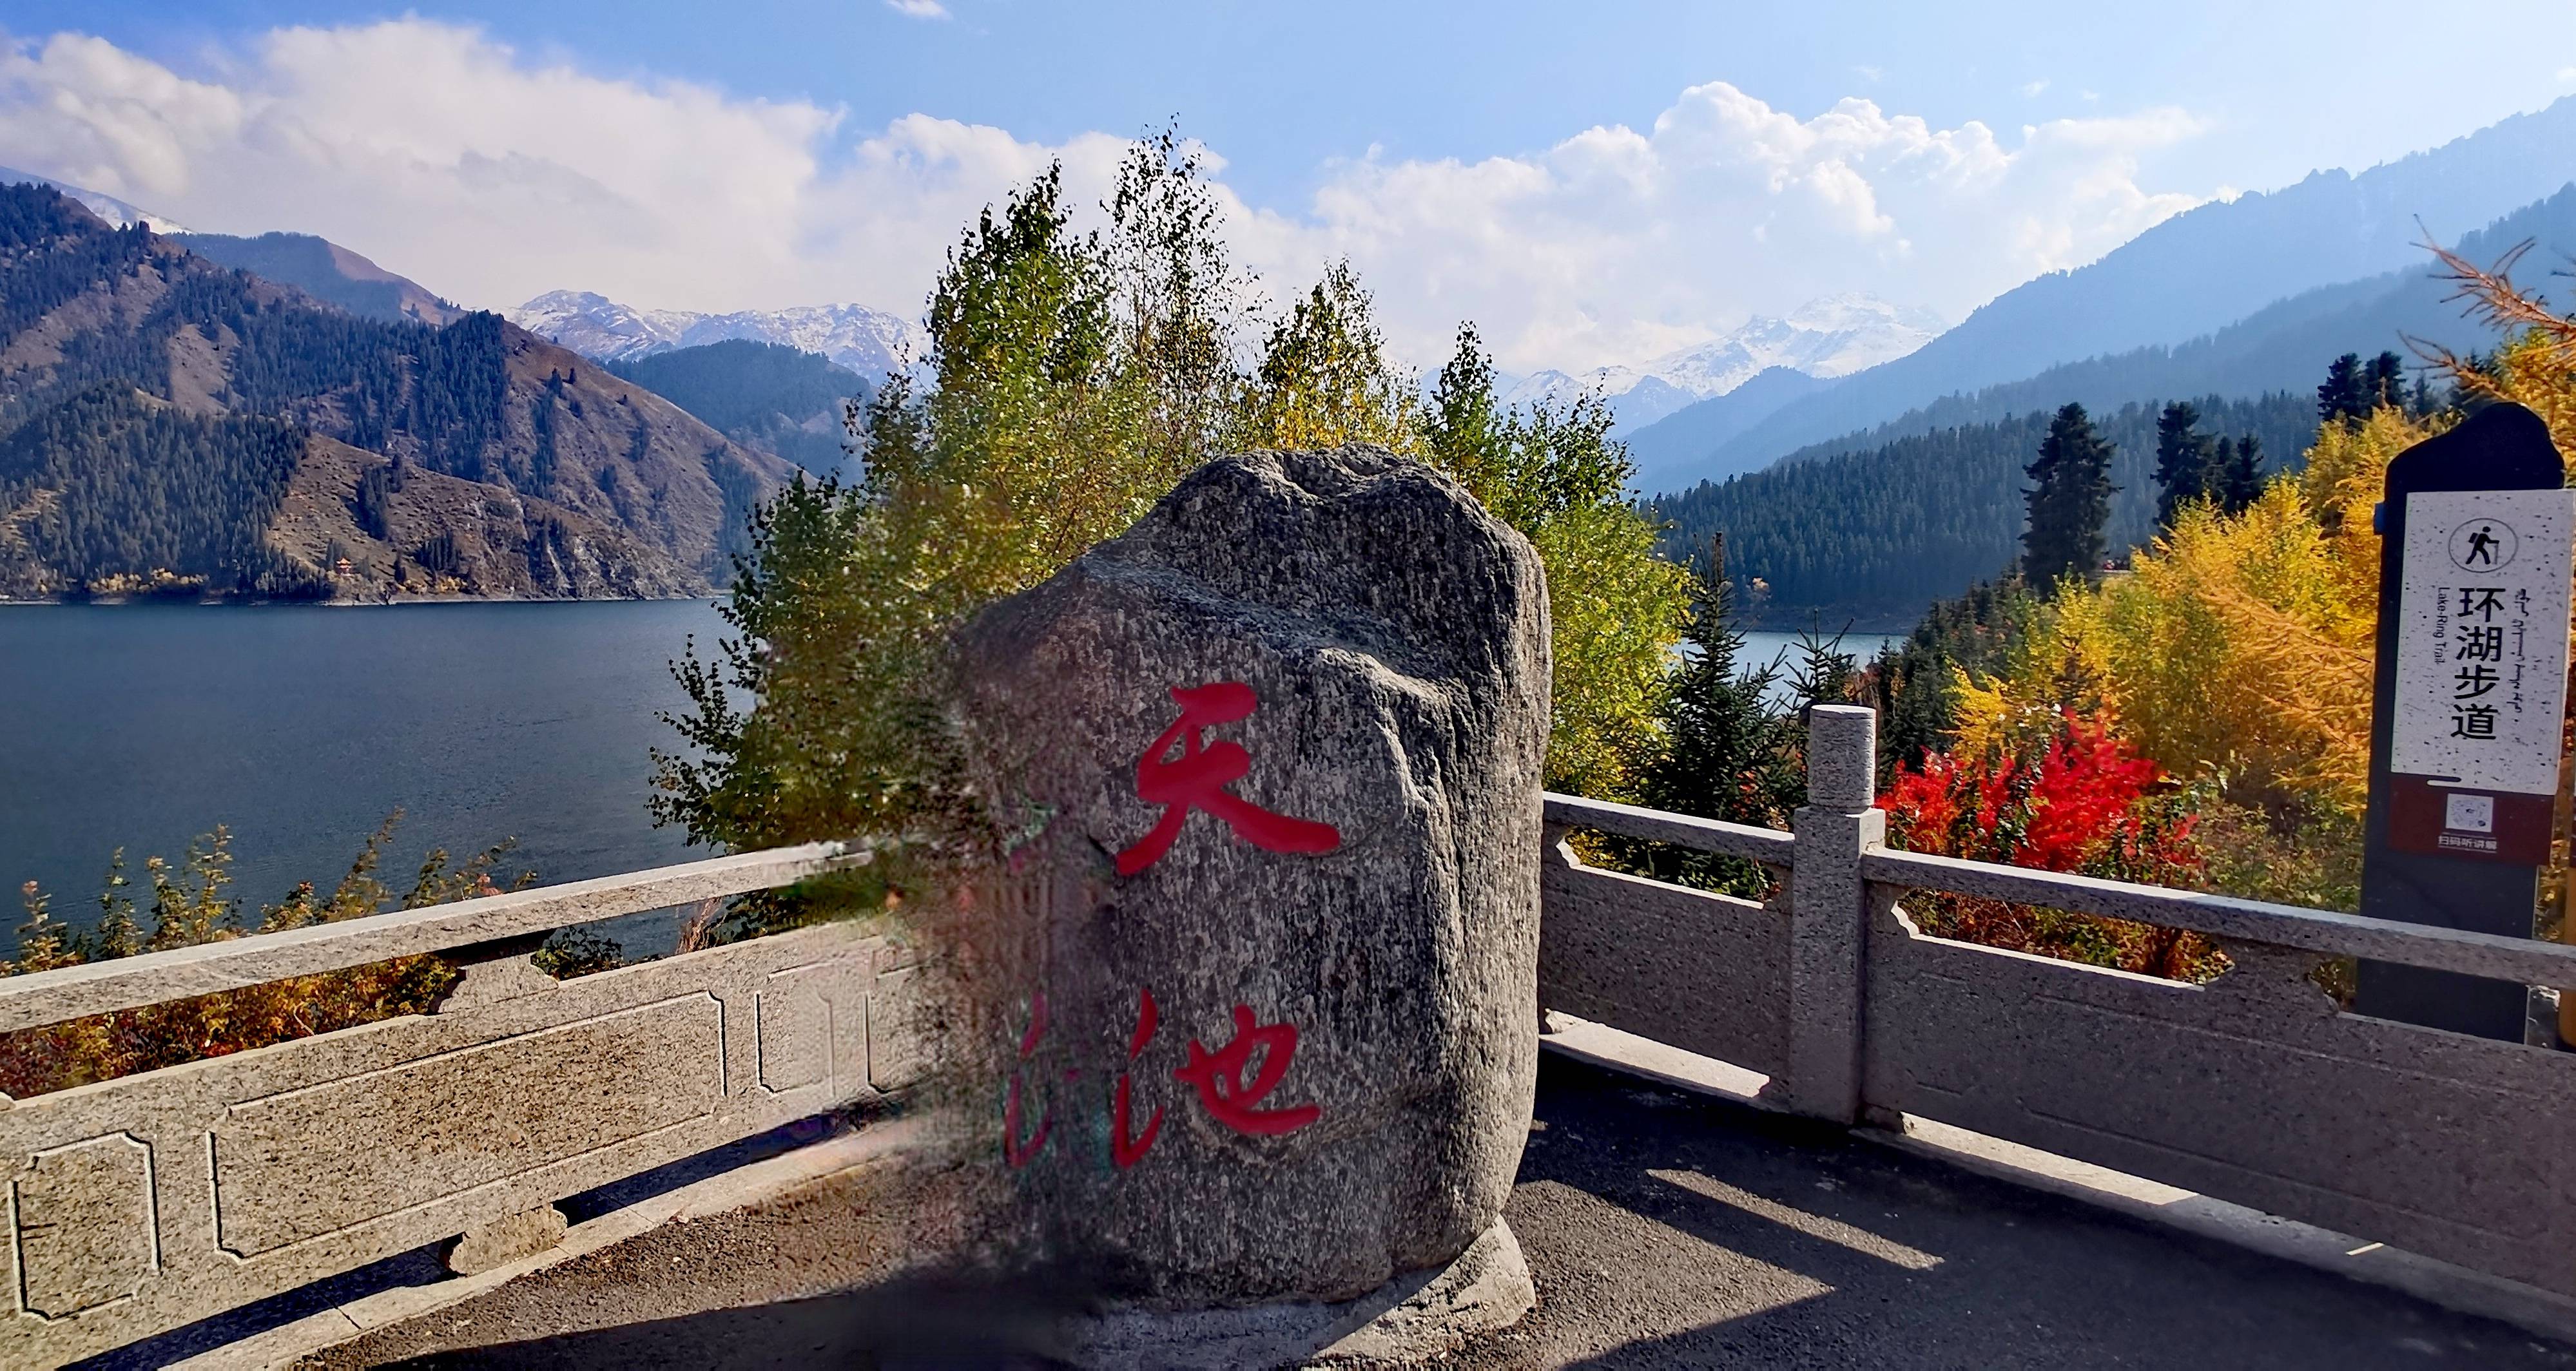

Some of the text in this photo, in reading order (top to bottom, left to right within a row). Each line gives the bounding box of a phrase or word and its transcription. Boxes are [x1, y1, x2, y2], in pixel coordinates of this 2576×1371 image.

[2433, 587, 2450, 664] Lake-Ring Trail
[2451, 587, 2506, 740] 环湖步道
[1115, 681, 1341, 1169] 天池
